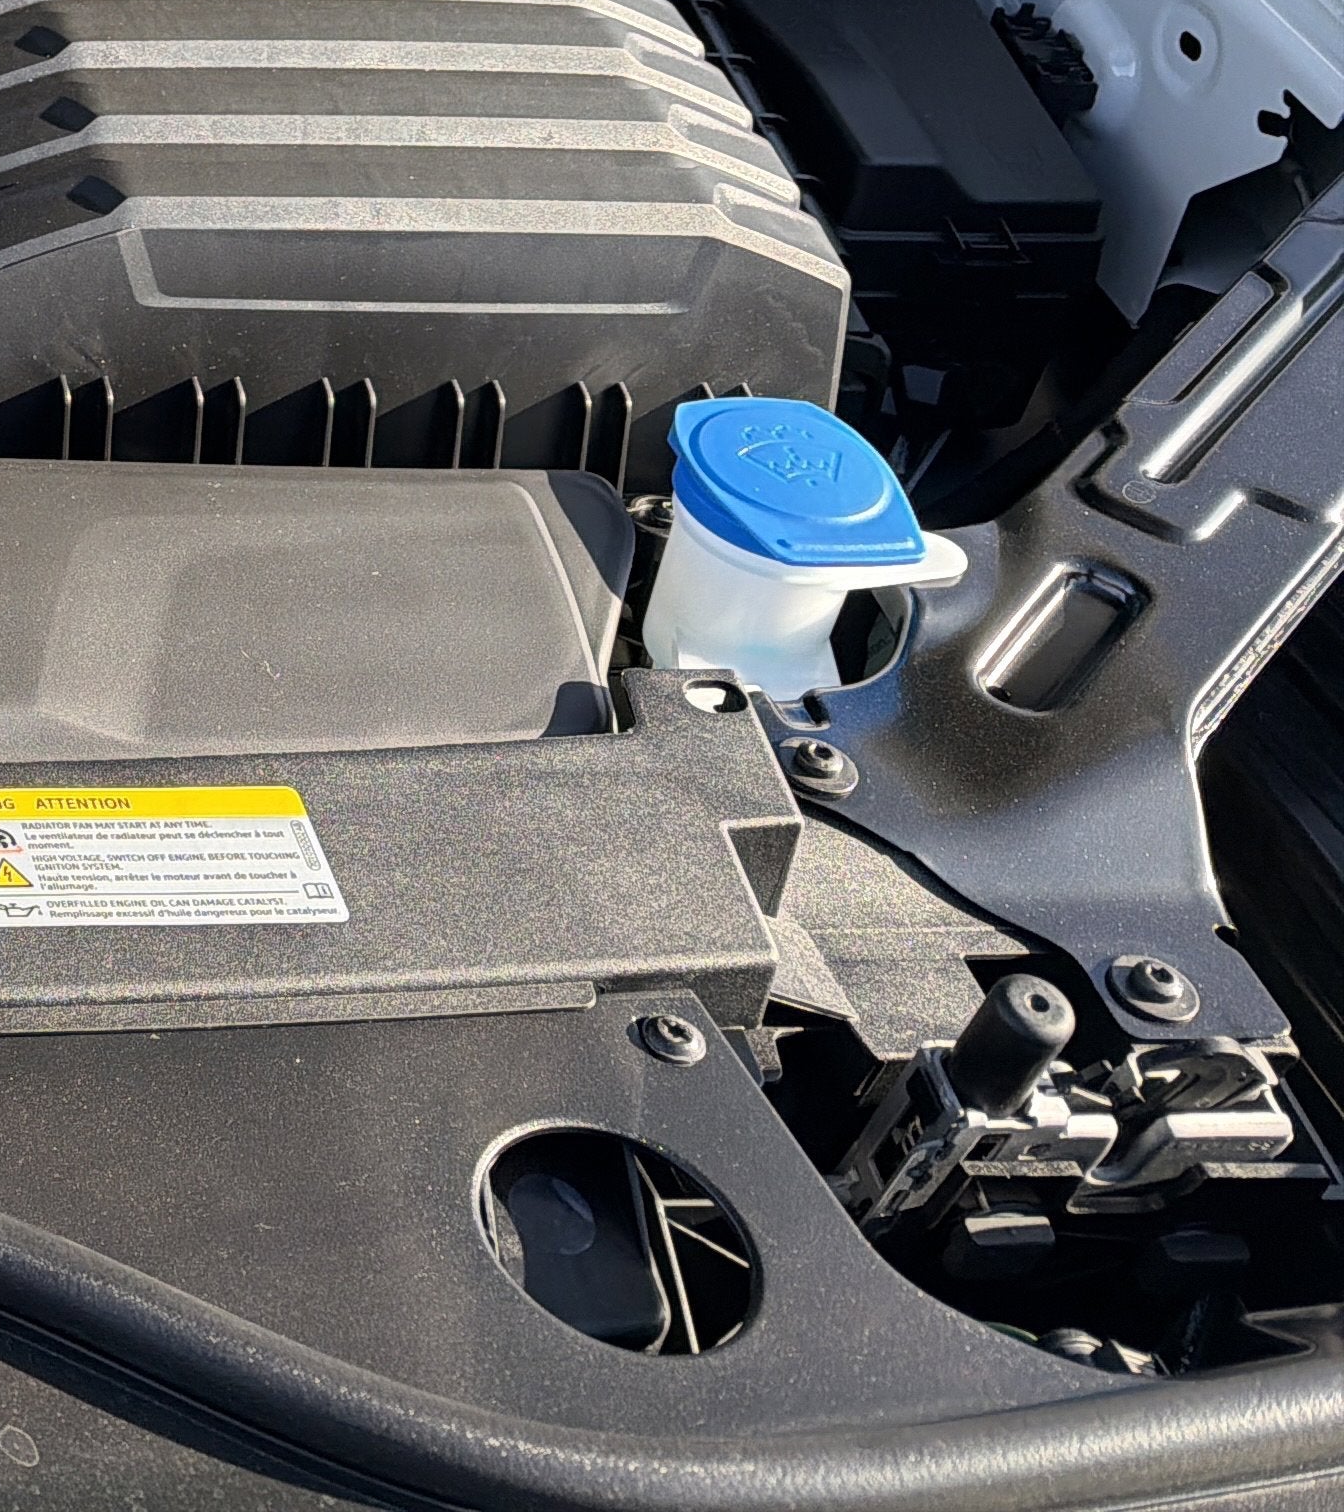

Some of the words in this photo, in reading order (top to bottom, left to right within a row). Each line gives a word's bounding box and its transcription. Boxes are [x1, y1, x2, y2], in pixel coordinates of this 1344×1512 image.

[36, 797, 131, 809] ATTENTION
[21, 822, 71, 830] RADIATOR
[117, 821, 147, 829] START
[150, 821, 161, 829] AT
[163, 821, 183, 829] ANY
[39, 832, 93, 840] ventilateur
[96, 832, 108, 840] de
[111, 832, 156, 840] radiateur
[159, 831, 183, 840] peut
[263, 830, 285, 838] tout
[32, 854, 57, 862] HIGH
[107, 854, 145, 862] SWITCH
[147, 853, 166, 861] OFF
[168, 852, 206, 861] ENGINE
[208, 852, 247, 861] BEFORE
[248, 851, 301, 860] TOUCHING
[35, 863, 80, 871] IGNITION
[38, 874, 70, 882] Haute
[163, 873, 201, 881] moteur
[203, 873, 232, 881] avant
[234, 872, 247, 880] de
[249, 871, 288, 880] toucher
[46, 900, 108, 908] OVERFILLED
[110, 899, 149, 908] ENGINE
[151, 899, 168, 907] OIL
[169, 898, 191, 907] CAN
[193, 898, 235, 906] DAMAGE
[194, 908, 247, 918] dangereux
[250, 908, 273, 918] pour
[275, 907, 285, 916] le
